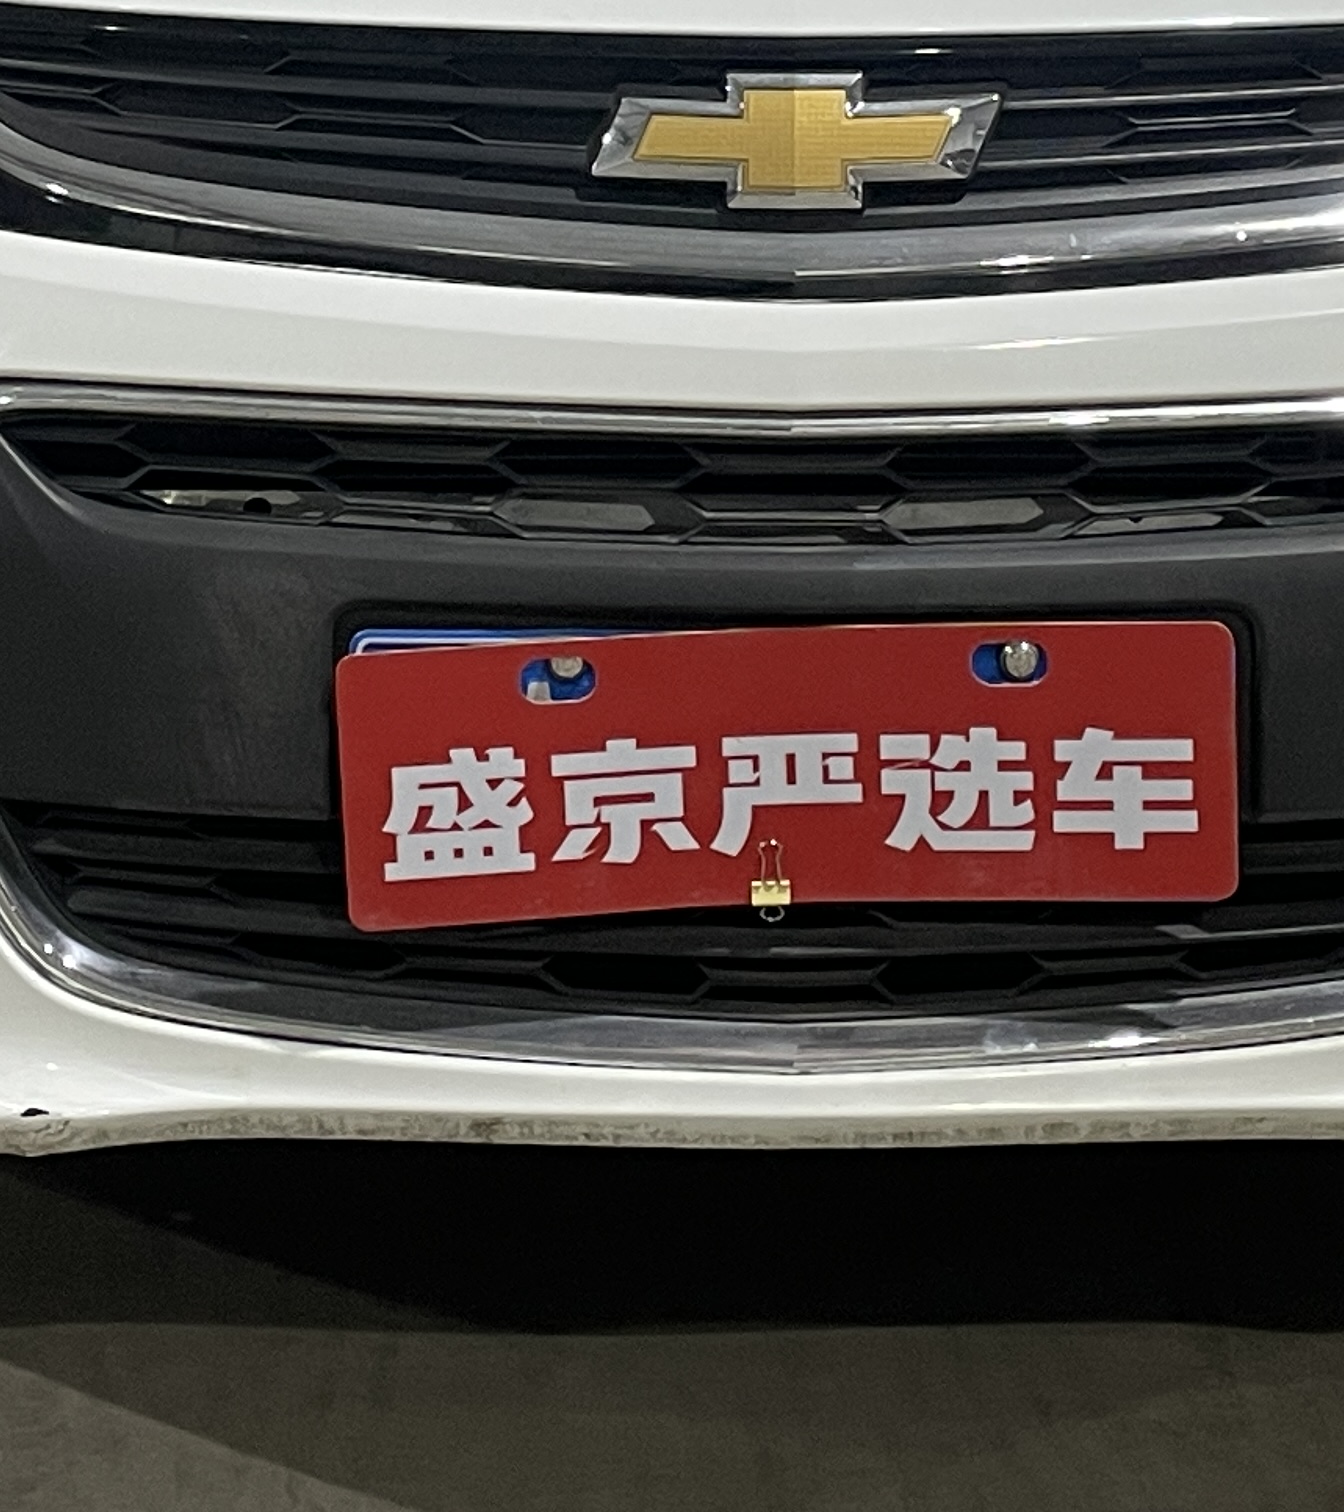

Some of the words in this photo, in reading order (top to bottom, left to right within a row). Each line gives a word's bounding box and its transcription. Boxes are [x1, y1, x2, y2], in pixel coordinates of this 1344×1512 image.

[383, 727, 1200, 882] 盛京严选车
